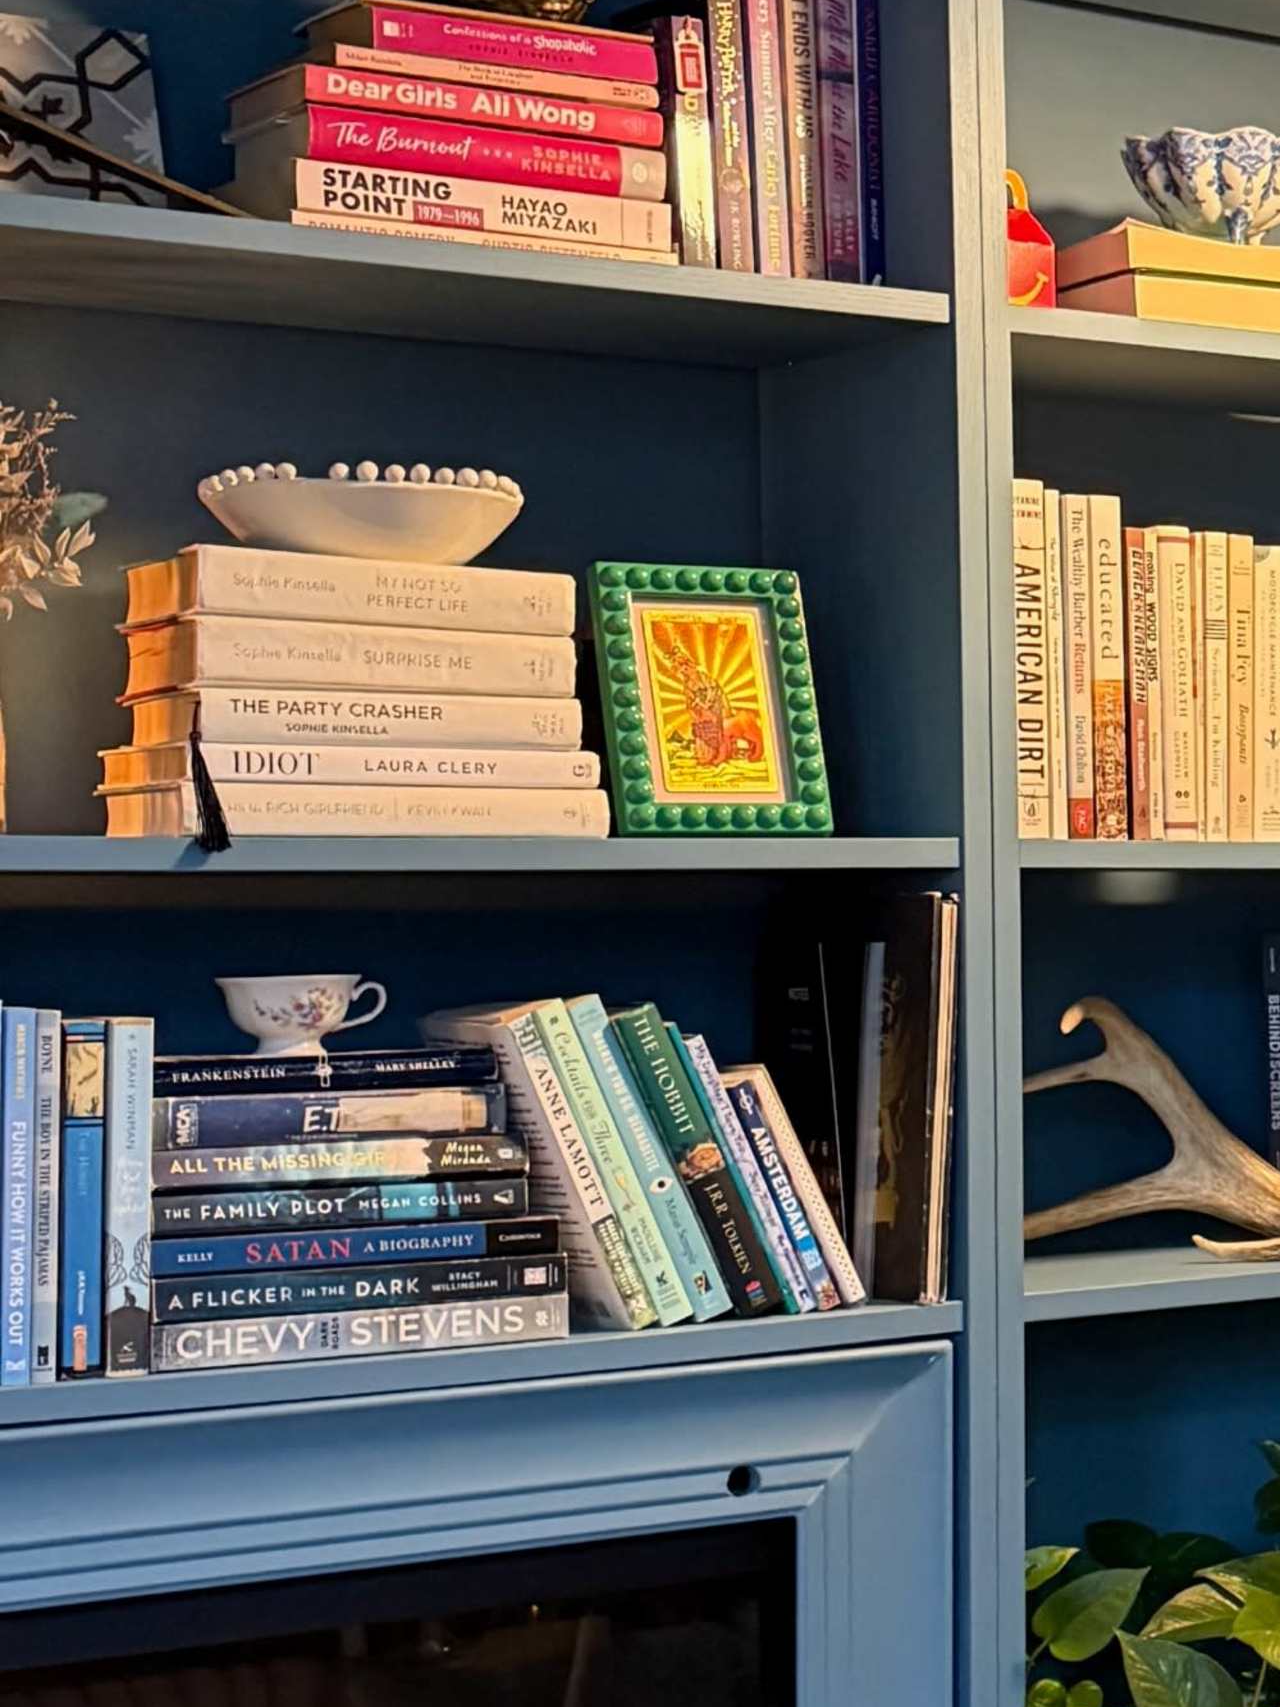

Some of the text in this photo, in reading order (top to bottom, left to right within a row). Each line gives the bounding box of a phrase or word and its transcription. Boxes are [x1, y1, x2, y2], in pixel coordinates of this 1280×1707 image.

[792, 11, 811, 59] ENDS
[326, 74, 596, 132] Dear Girls Ali Wong
[794, 64, 812, 109] WITH
[327, 121, 477, 161] The Burnout
[798, 114, 814, 139] US
[521, 158, 612, 183] KINSELLA
[531, 146, 603, 167] SOPHIE
[831, 132, 851, 184] Lake
[322, 168, 452, 201] STARTING
[501, 195, 568, 217] HAYAO
[501, 209, 598, 236] MIYAZAKI
[233, 573, 335, 594] Sophie Kinsella
[1098, 538, 1119, 661] educated
[1174, 563, 1186, 612] DAVID
[366, 594, 470, 614] PERFECT LIFE
[1071, 509, 1086, 695] The Wealthy Barber Returns
[363, 649, 473, 671] SURPRISE ME
[1230, 609, 1251, 686] Tina Fey
[1015, 563, 1045, 778] AMERICAN DIRT
[1176, 646, 1189, 718] GOLIATH
[230, 697, 443, 721] THE PARTY CRASHER
[285, 722, 389, 736] SOPHIE KINSELLA
[1236, 703, 1251, 765] Bossypants
[232, 750, 498, 776] IDIOT LAURA CLERY
[171, 1066, 287, 1083] FRANKENSTEIN
[374, 1059, 457, 1074] MARY SHELLEY
[632, 1015, 696, 1135] THE HOBBIT
[124, 1048, 138, 1151] SARAH WINMAN
[302, 1104, 341, 1132] E.T
[445, 1141, 484, 1158] Megan
[535, 1067, 605, 1207] ANNE LAMOTT
[36, 1034, 53, 1287] BOYNE THE BOY IN THE STRIPED PAJAMAS
[170, 1157, 208, 1174] ALL
[213, 1156, 254, 1173] THE
[261, 1151, 346, 1171] MISSING
[440, 1154, 492, 1167] Miranda
[751, 1127, 809, 1242] AMSTERDAM
[163, 1192, 482, 1221] THE FAMILY PLOT MEGAN COLLINS
[8, 1121, 27, 1347] FUNNY HOW IT WORKS OUT
[177, 1233, 475, 1264] KELLY SATAN A BIOGRAPHY
[721, 1219, 752, 1275] TOLKIEN
[430, 1277, 499, 1292] WILLINGHAM
[448, 1271, 483, 1282] STACY
[168, 1277, 421, 1311] A FLICKER IN THE DARK
[175, 1305, 526, 1359] CHEVY STEVENS
